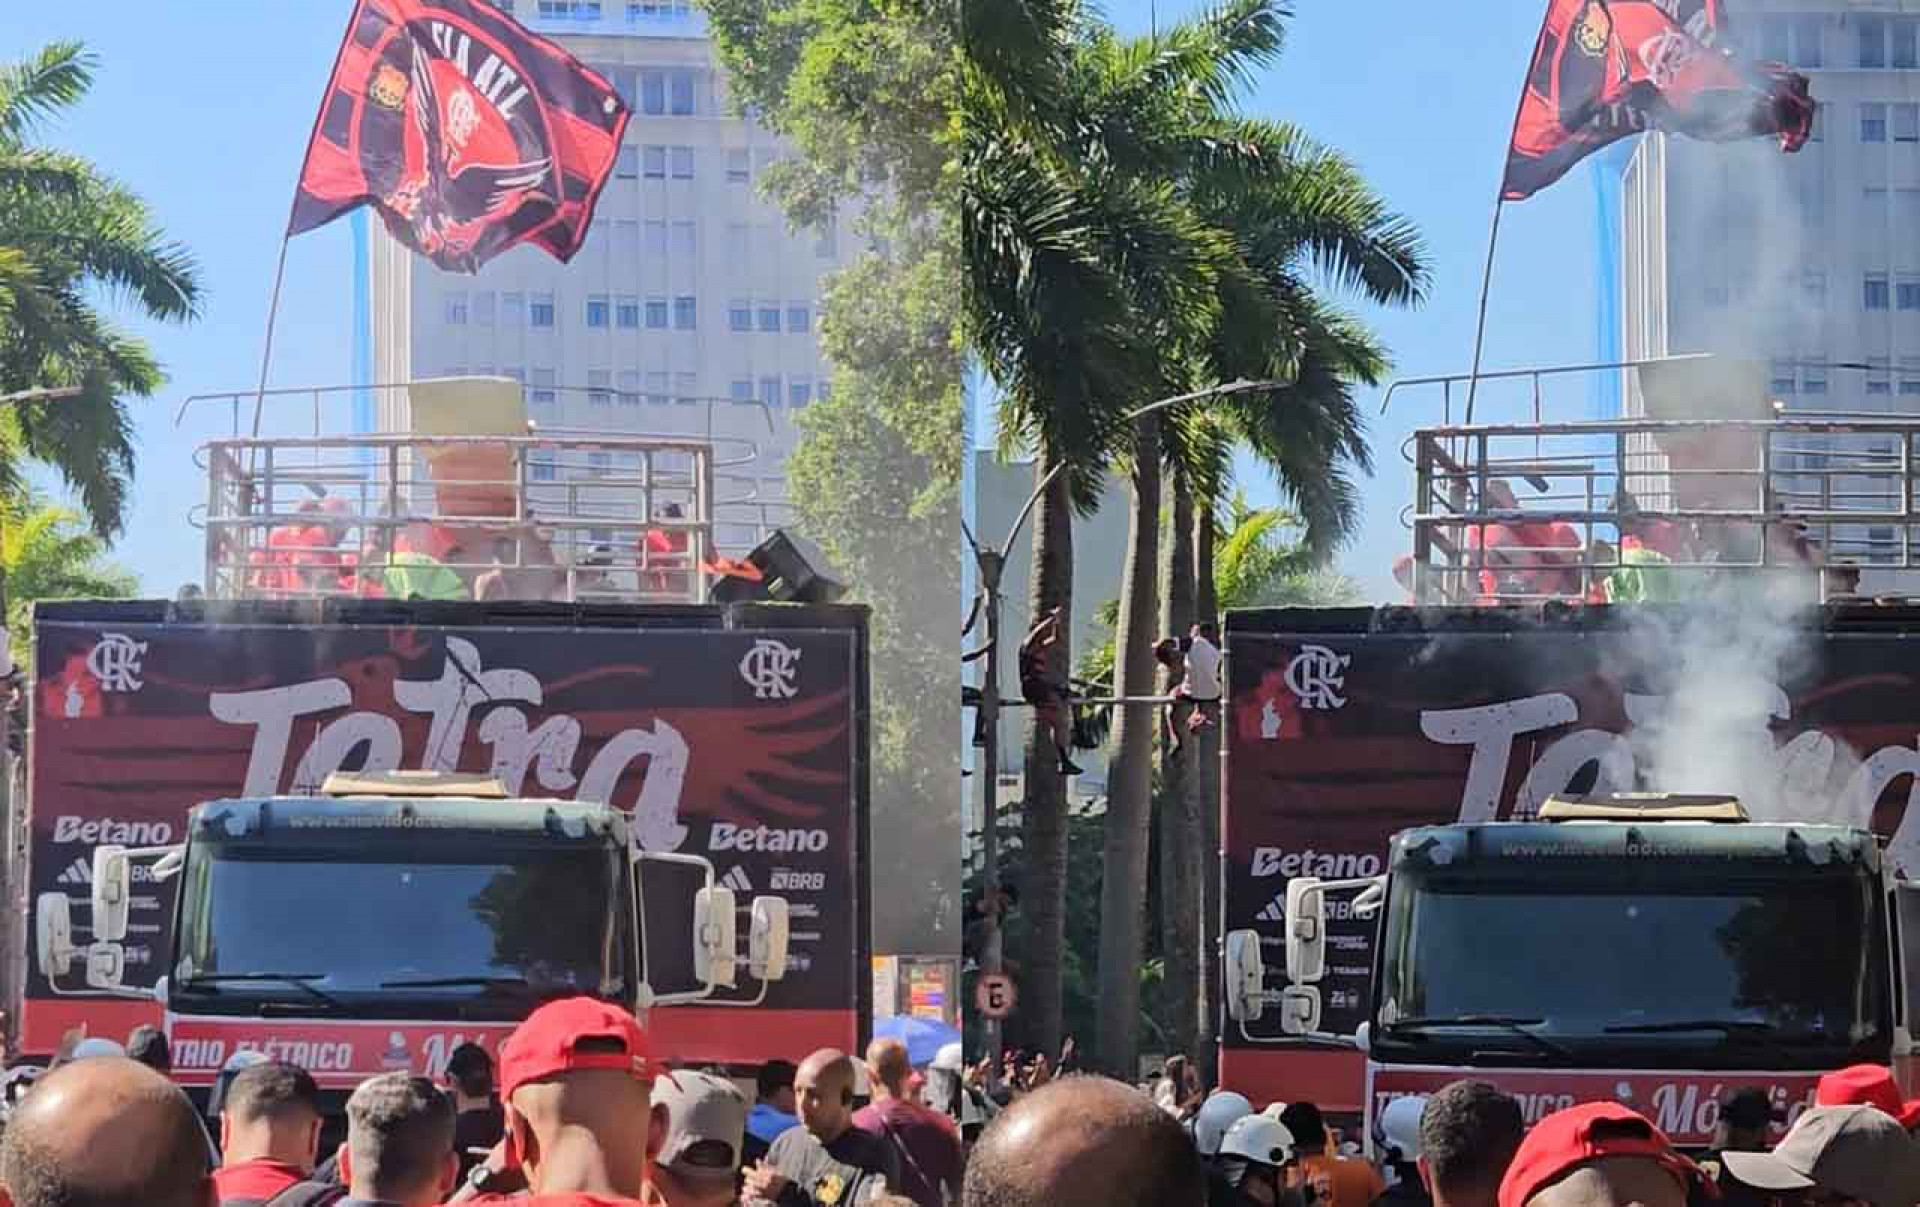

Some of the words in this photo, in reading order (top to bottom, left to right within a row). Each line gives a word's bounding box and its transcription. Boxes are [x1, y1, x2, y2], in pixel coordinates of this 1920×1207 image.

[53, 815, 171, 845] Betano
[707, 822, 829, 852] Betano
[131, 863, 164, 883] BR
[1250, 846, 1381, 878] Betano
[789, 873, 826, 890] BRB
[172, 1040, 225, 1068] TRIO
[231, 1036, 353, 1069] ÉTRICO
